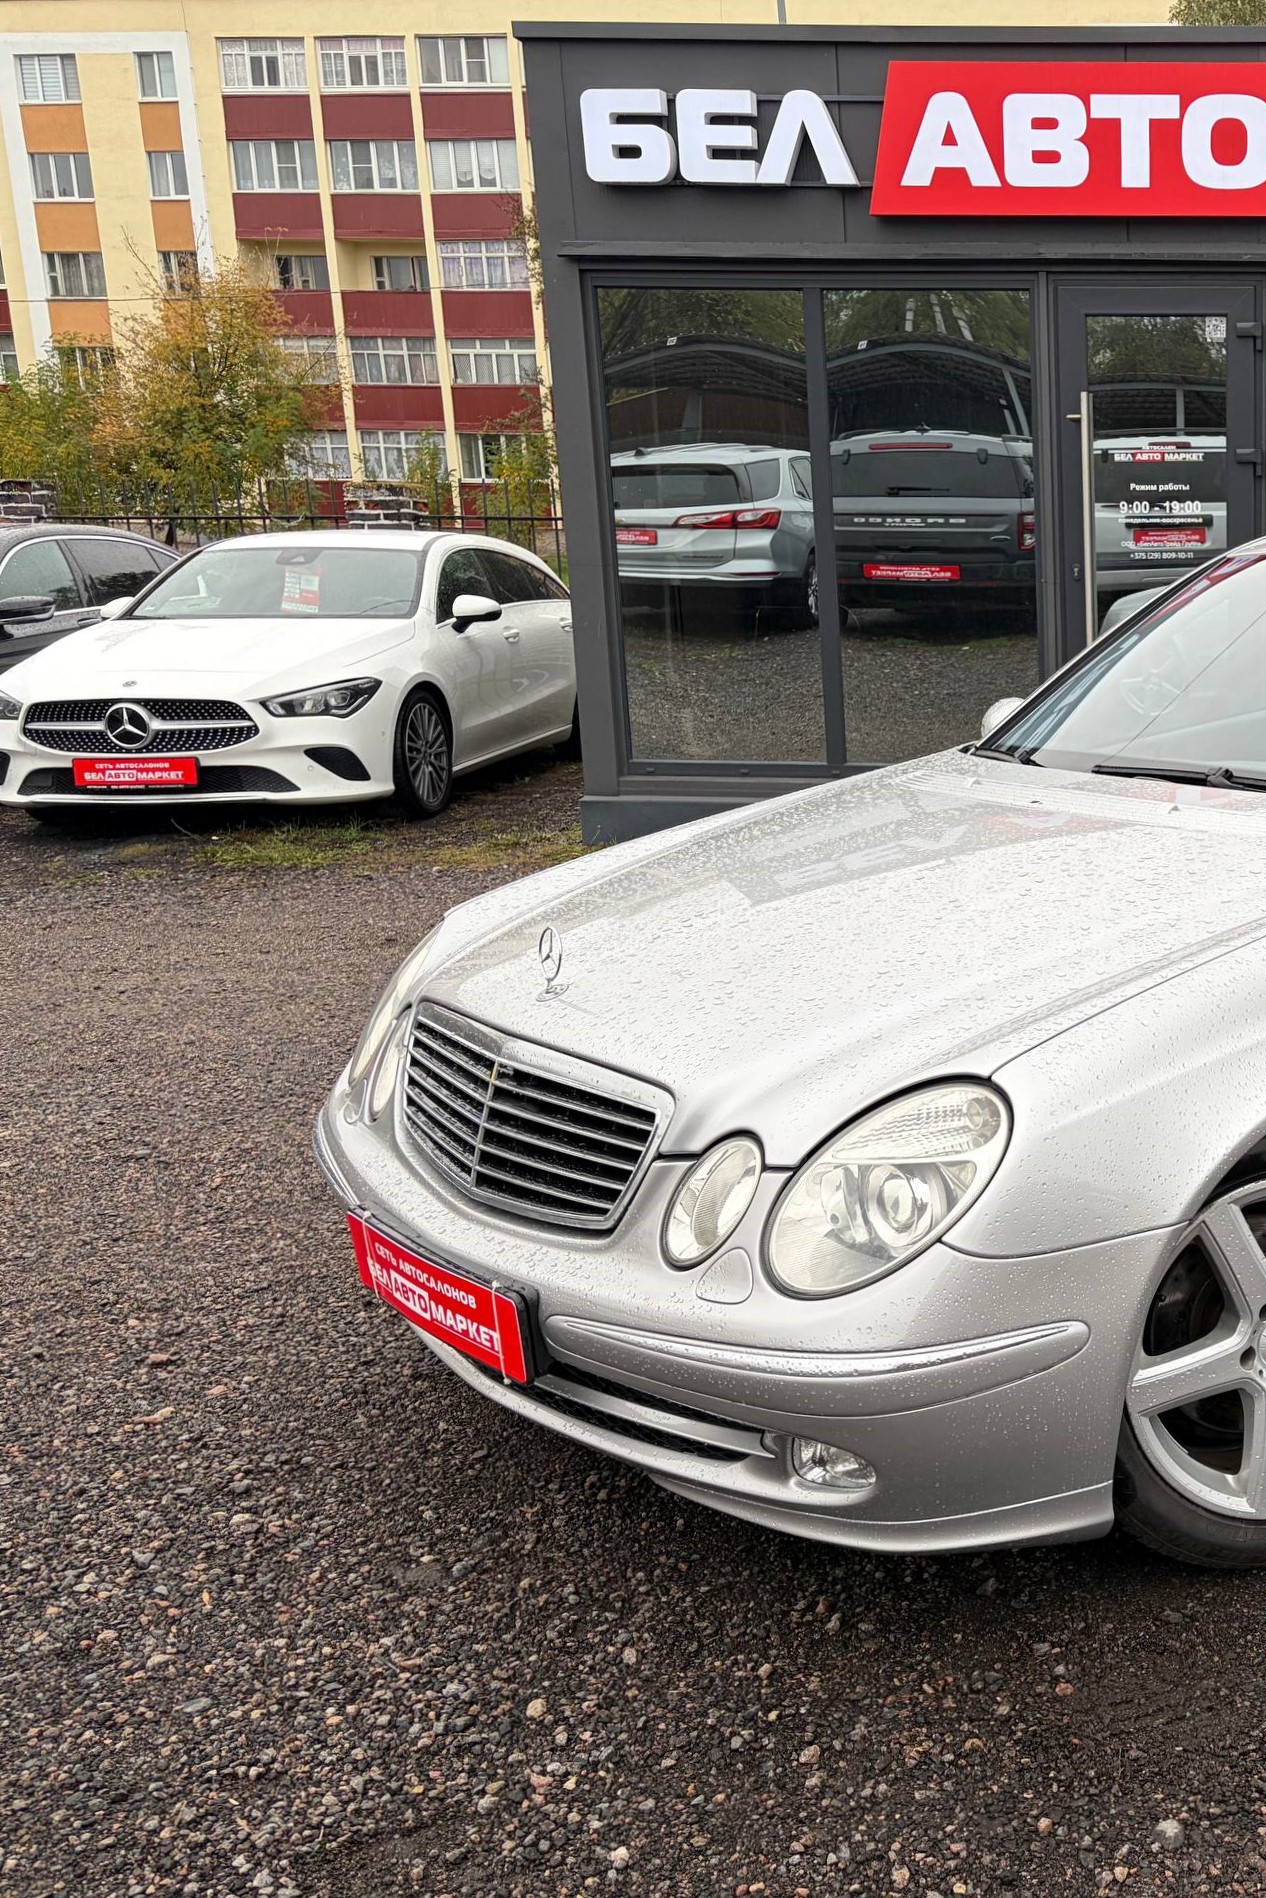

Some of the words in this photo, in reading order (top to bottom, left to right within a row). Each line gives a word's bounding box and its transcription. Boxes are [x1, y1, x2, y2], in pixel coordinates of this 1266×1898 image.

[579, 87, 860, 186] БЕЛ
[1113, 452, 1133, 462] БЕЛ
[1135, 452, 1161, 461] АВТО
[1164, 452, 1205, 462] МАРКЕТ
[1129, 483, 1158, 491] Режим
[1159, 482, 1190, 492] работы
[1119, 501, 1150, 514] 9:00
[1164, 501, 1202, 514] 19:00
[1147, 552, 1161, 560] (29)
[84, 772, 105, 780] БЕЛ
[106, 771, 136, 780] АВТО
[138, 771, 184, 780] МАРКЕТ
[374, 1242, 398, 1267] СЕТЬ
[399, 1258, 477, 1310] АВТОСАЛОНОВ
[367, 1257, 392, 1289] БЕЛ
[392, 1277, 429, 1312] АВТО
[430, 1300, 502, 1352] МАРКЕТ
